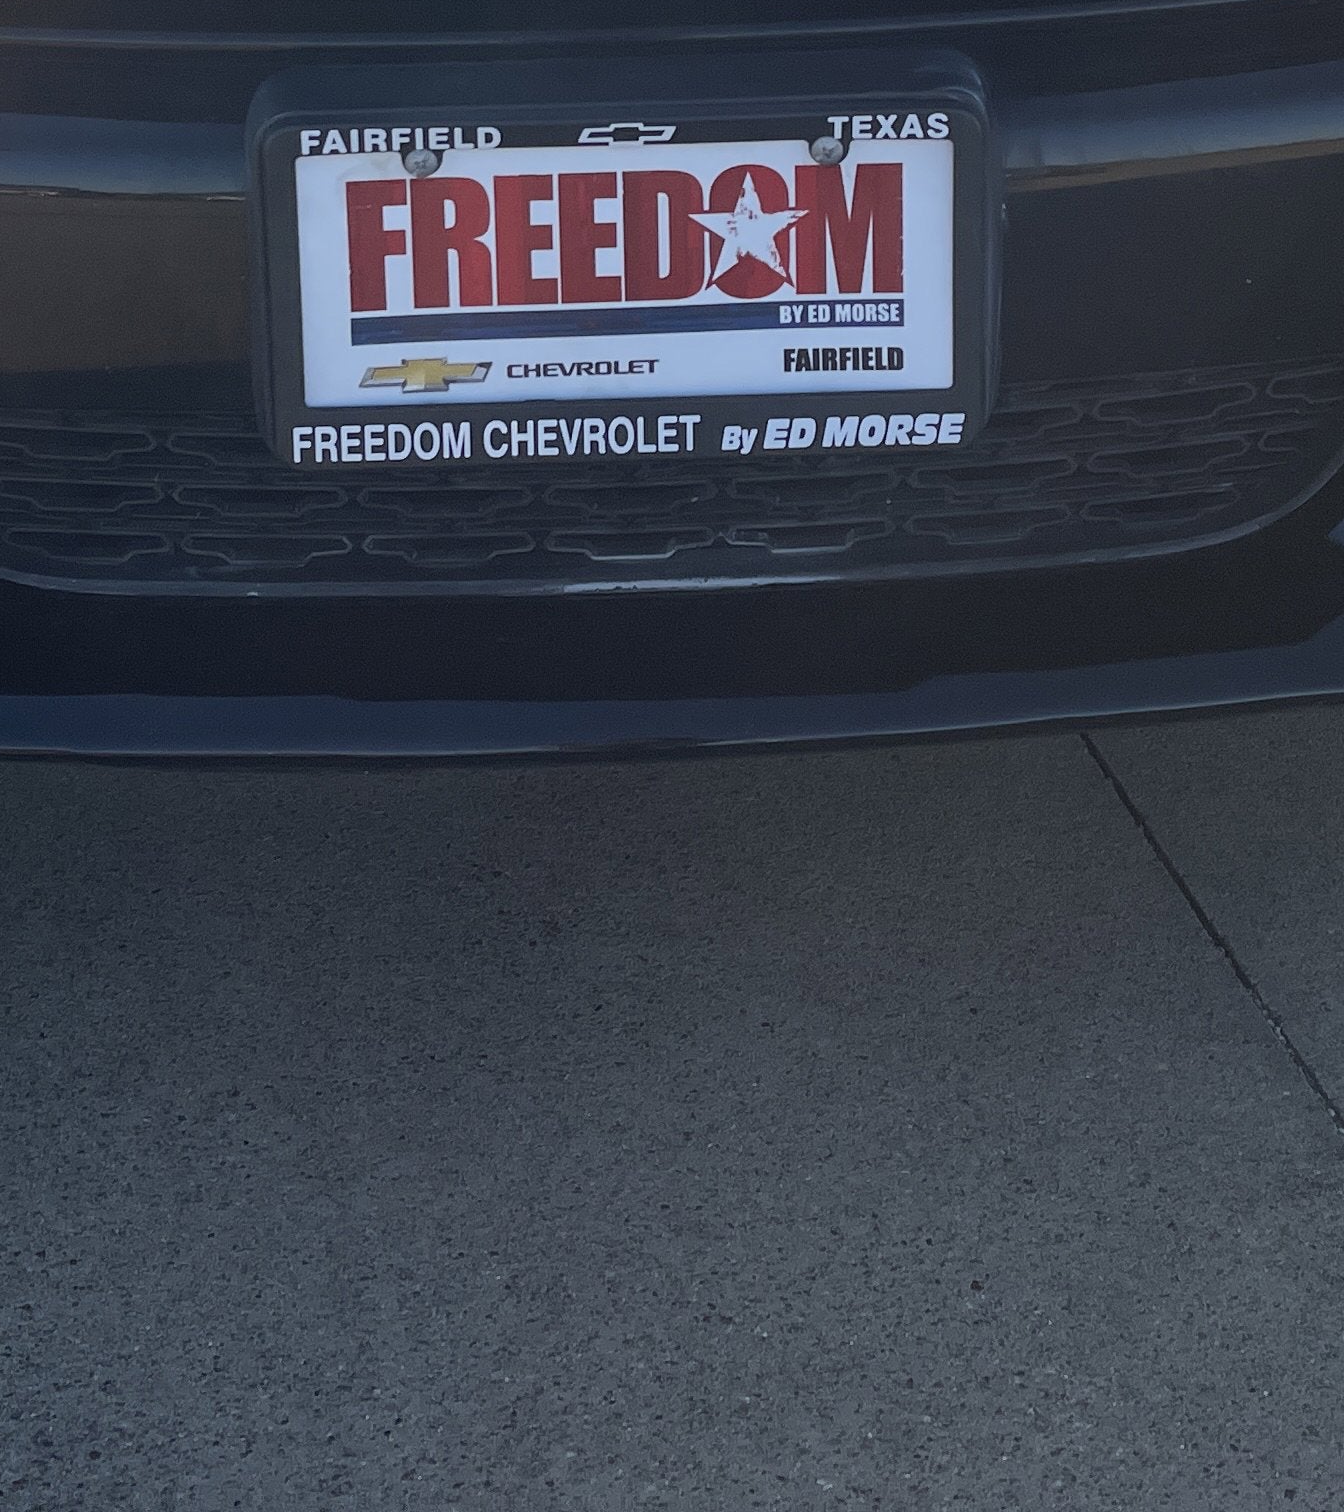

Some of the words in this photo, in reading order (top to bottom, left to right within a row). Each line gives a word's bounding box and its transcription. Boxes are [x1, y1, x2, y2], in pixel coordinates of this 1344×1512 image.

[827, 113, 950, 139] TEXAS
[300, 126, 502, 155] FAIRFIELD
[345, 163, 904, 312] FREEDOM
[779, 305, 804, 324] BY
[808, 304, 831, 323] ED
[835, 303, 900, 322] MORSE
[506, 359, 660, 379] CHEVROLET
[783, 347, 904, 373] FAIRFIELD
[292, 421, 472, 463] FREEDOM
[483, 414, 702, 459] CHEVROLET
[721, 425, 758, 455] By
[763, 418, 817, 450] ED
[822, 413, 965, 449] MORSE
